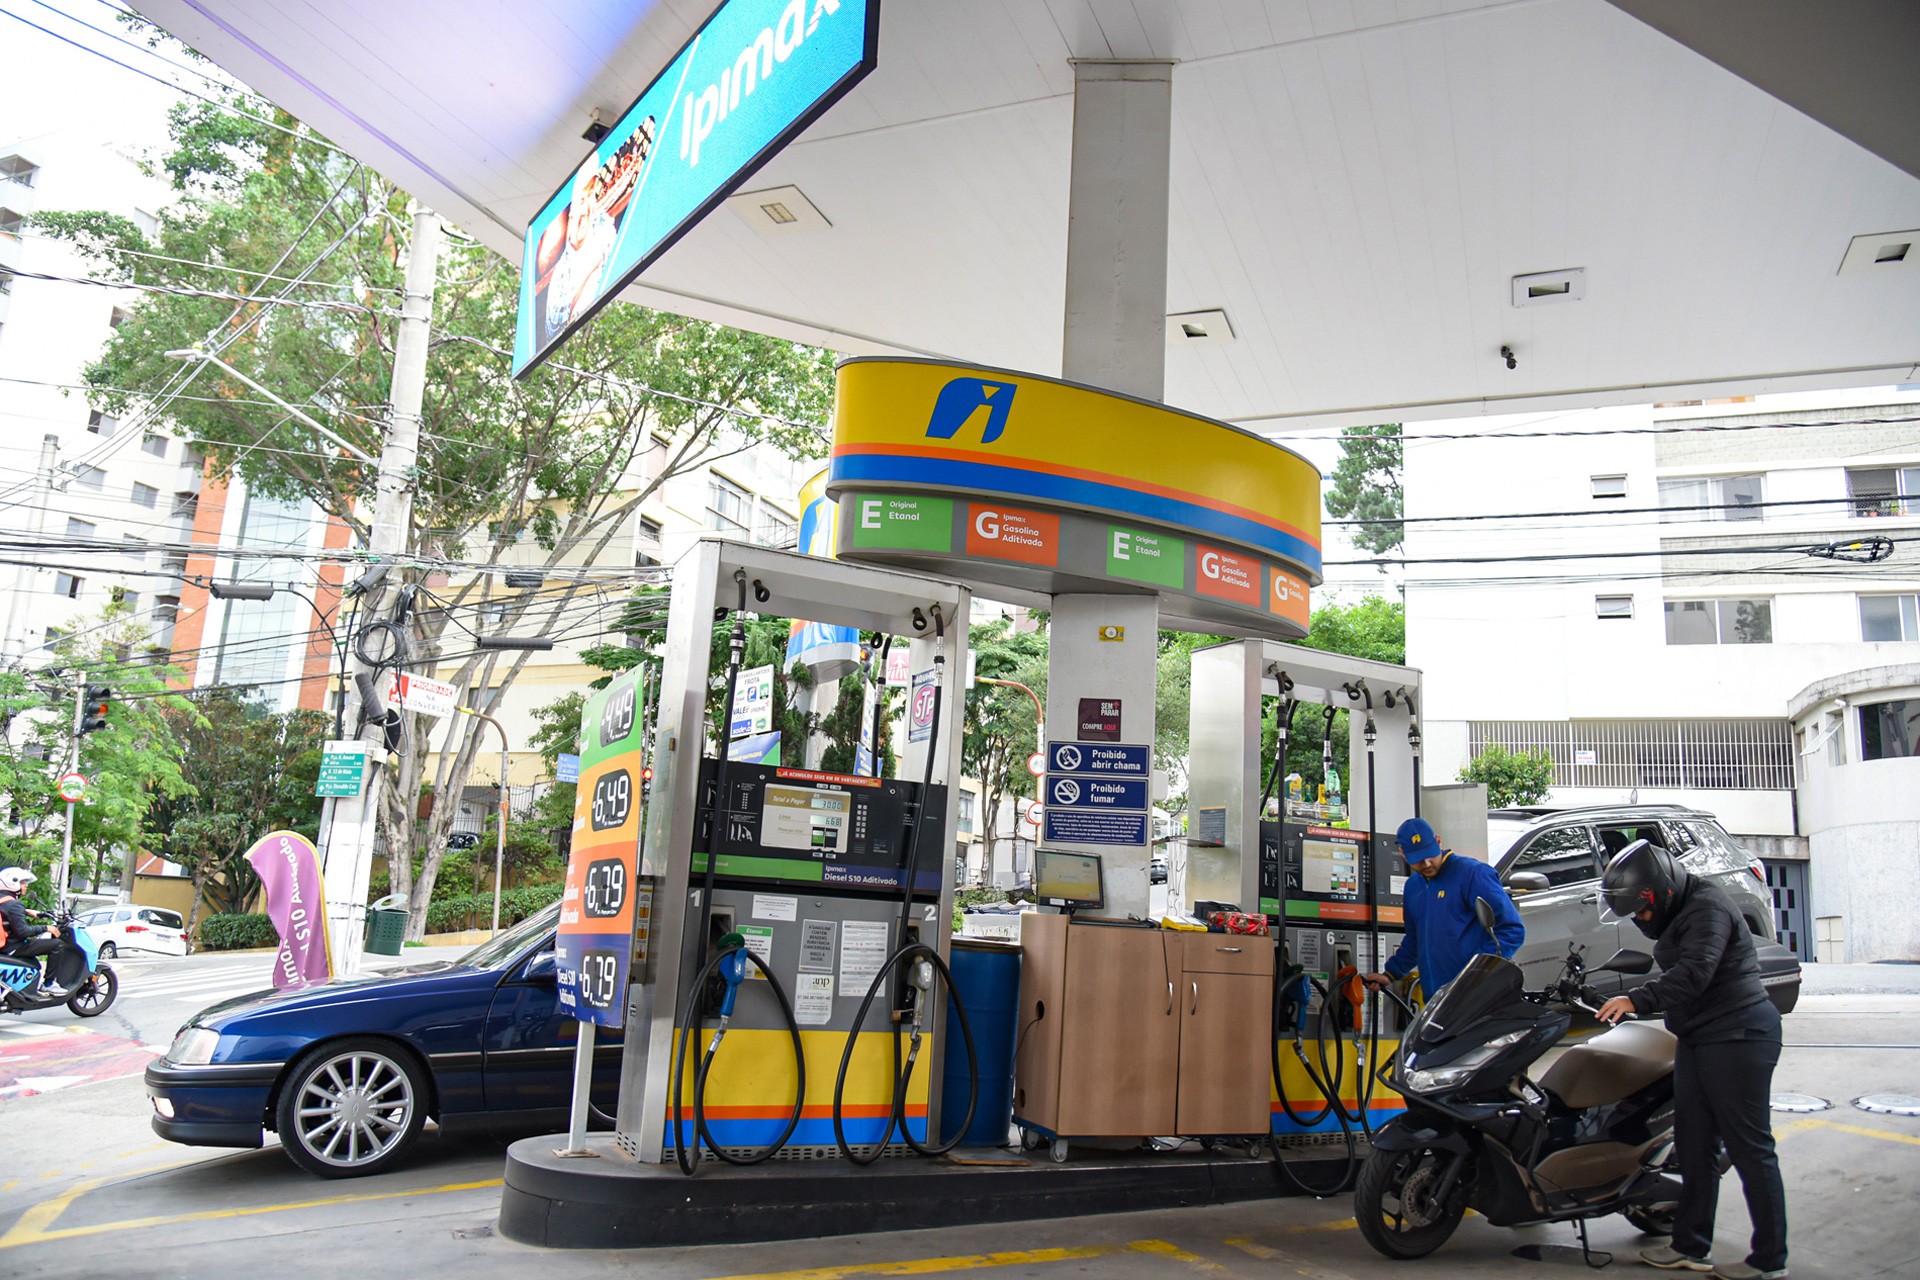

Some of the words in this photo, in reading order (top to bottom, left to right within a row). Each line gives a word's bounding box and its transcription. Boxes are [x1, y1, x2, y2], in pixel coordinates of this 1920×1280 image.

[889, 501, 917, 510] Original
[861, 500, 883, 529] E
[889, 511, 920, 521] Etanol
[975, 511, 999, 539] G
[1002, 524, 1039, 536] Gasolina
[1002, 534, 1043, 547] Aditivada
[1113, 531, 1130, 560] E
[1135, 535, 1158, 545] Original
[1135, 545, 1160, 557] Etanol
[1201, 552, 1220, 579] G
[1221, 565, 1248, 578] Gasolina
[1221, 575, 1251, 589] Aditivada
[1275, 575, 1288, 601] G
[411, 679, 453, 697] PRIORIDADE
[744, 677, 760, 691] FROTA
[426, 694, 436, 702] NA
[915, 690, 934, 721] STP
[1101, 702, 1113, 710] SEM
[1101, 709, 1119, 717] PARAR
[1092, 749, 1127, 759] Proibido
[1091, 760, 1112, 770] abrir
[1113, 761, 1141, 770] chama
[1091, 783, 1125, 794] Proibido
[595, 775, 629, 824] 6,49
[773, 795, 786, 803] Total
[790, 797, 806, 805] Pagar
[1090, 794, 1115, 803] fumar
[824, 873, 847, 881] Diesel
[848, 875, 861, 883] S10
[862, 876, 897, 885] Aditivado
[587, 865, 624, 912] 6,79
[690, 890, 701, 907] 1
[925, 905, 937, 922] 2
[1326, 931, 1335, 945] 6
[583, 955, 616, 1002] 6,79
